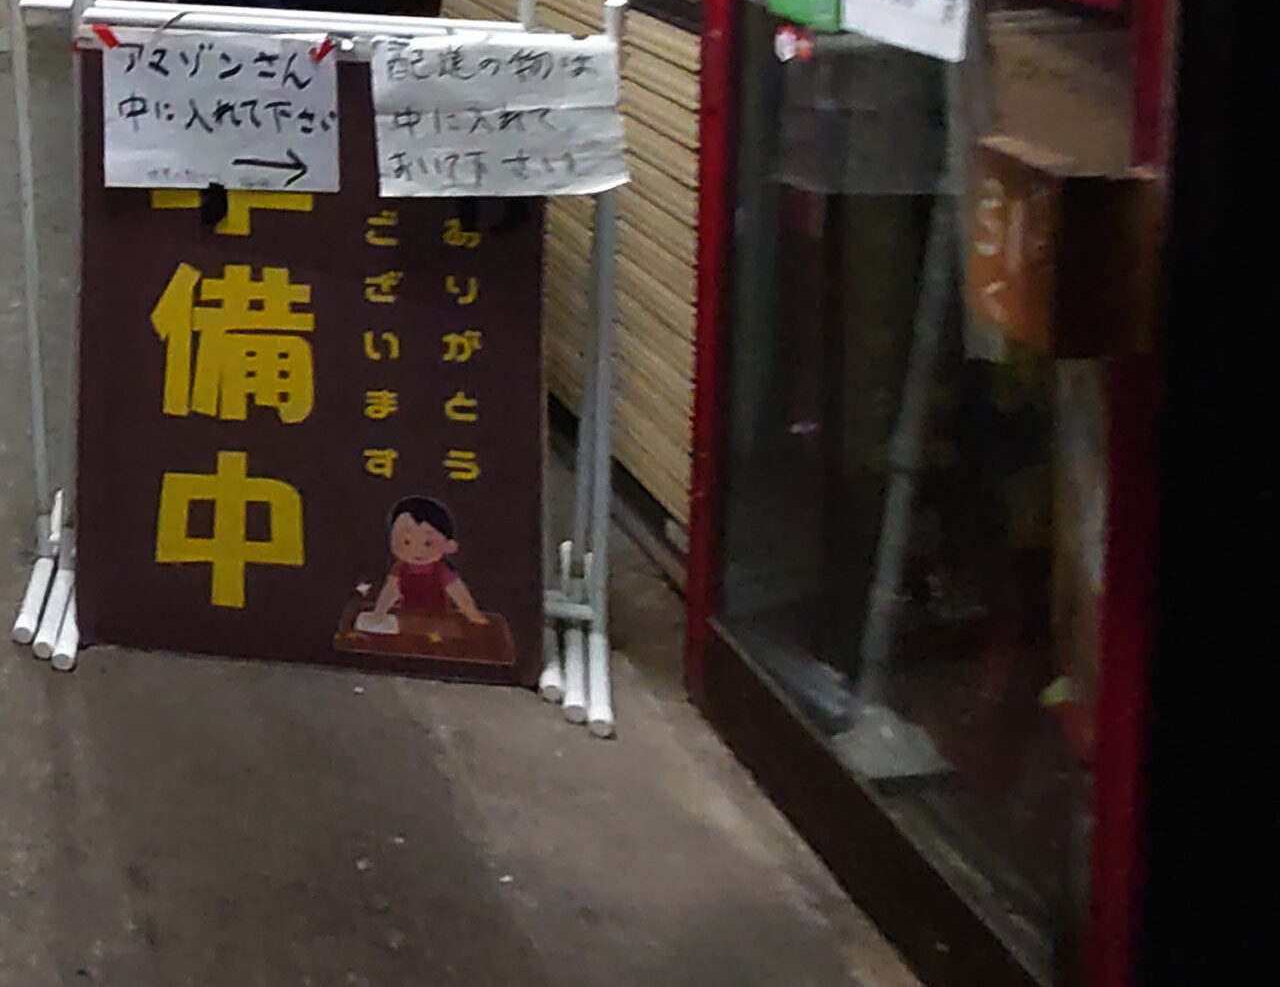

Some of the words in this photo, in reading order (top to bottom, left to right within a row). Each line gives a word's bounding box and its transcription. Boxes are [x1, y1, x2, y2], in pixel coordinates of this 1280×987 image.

[117, 41, 313, 91] アマゾンさん
[117, 92, 338, 134] 中に入れて下さい
[393, 105, 558, 136] 中に入れて
[363, 209, 401, 480] ございます
[441, 217, 483, 481] ありがとう
